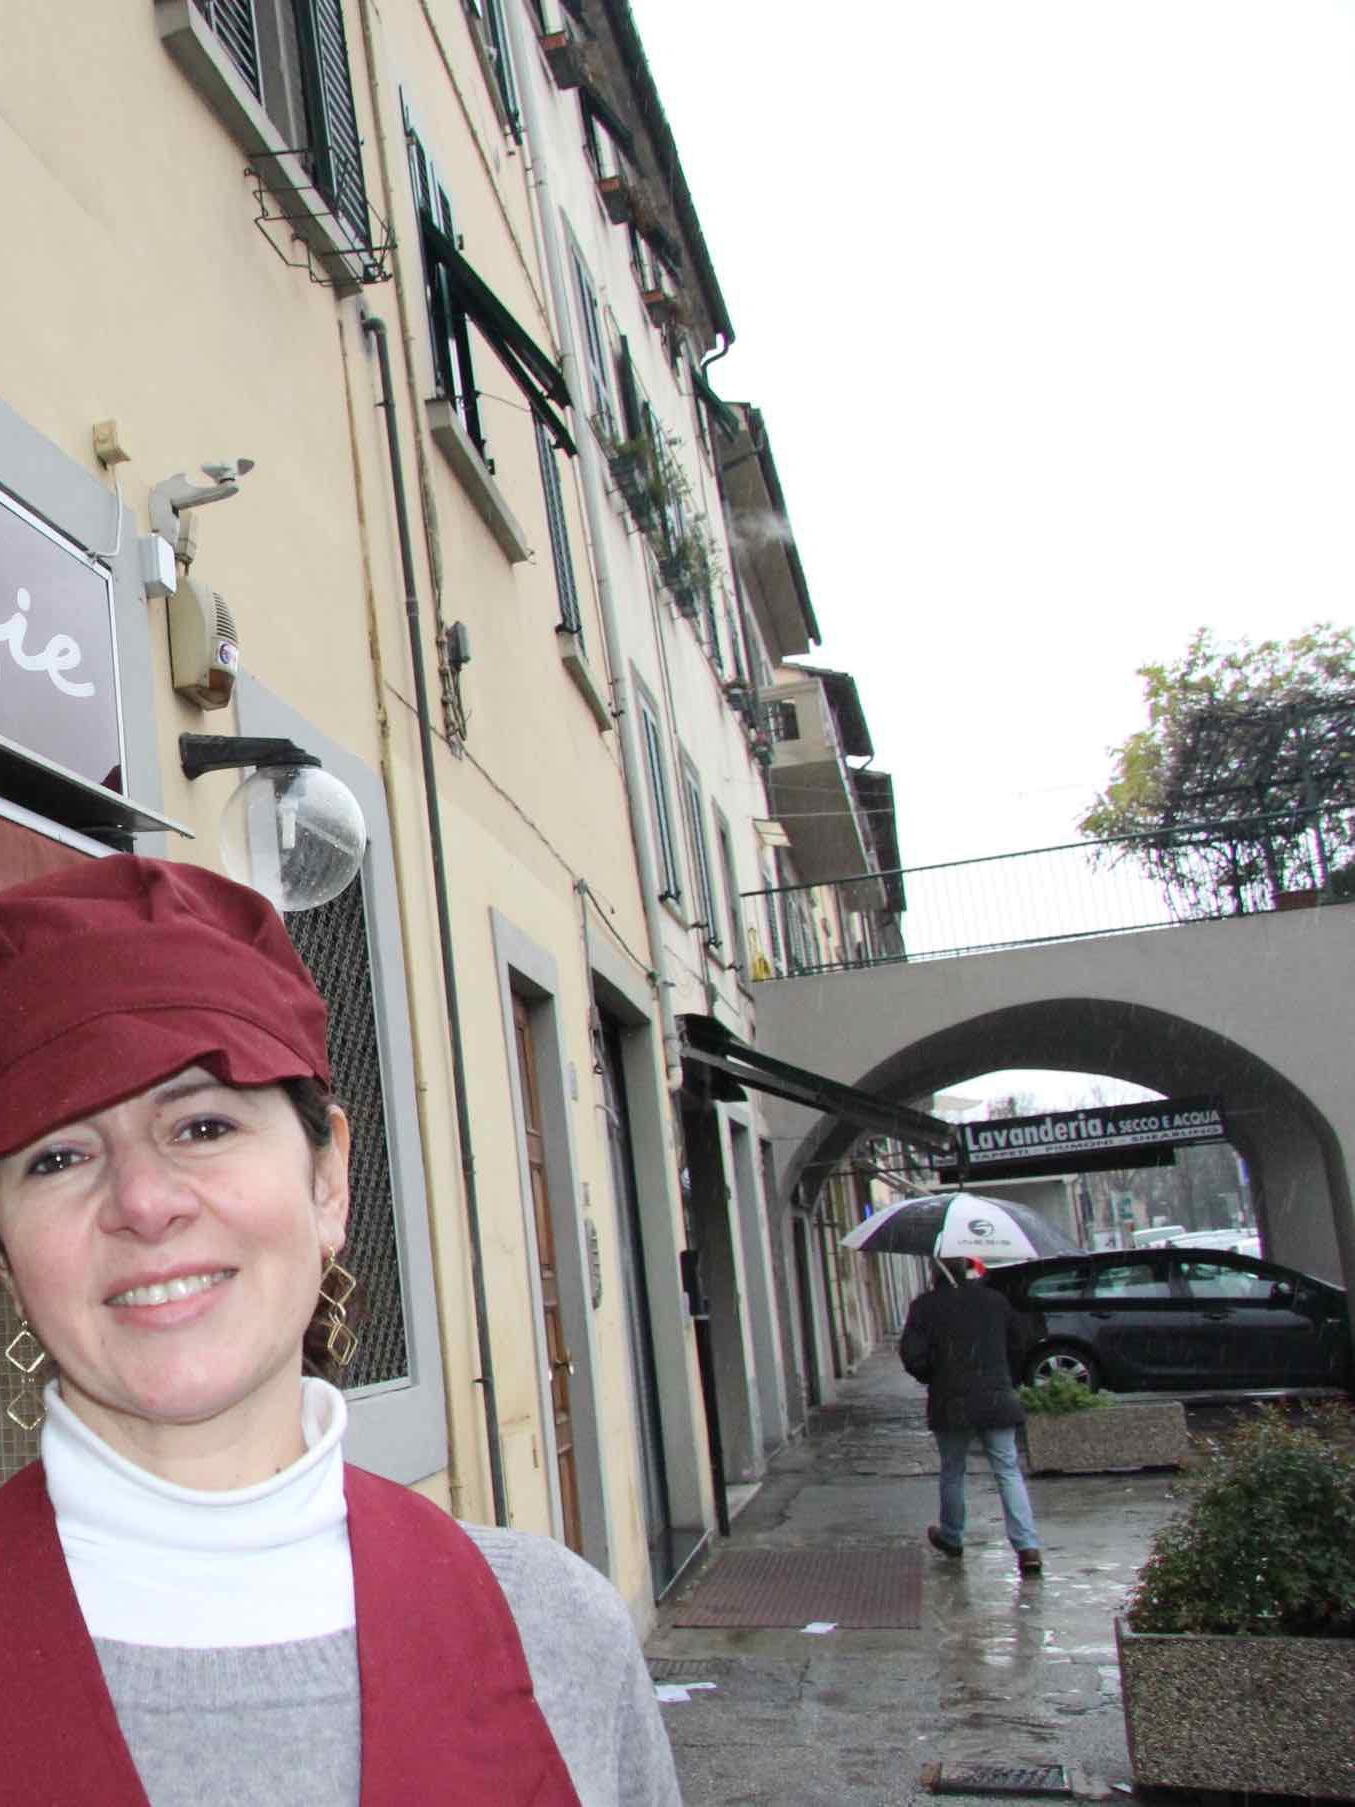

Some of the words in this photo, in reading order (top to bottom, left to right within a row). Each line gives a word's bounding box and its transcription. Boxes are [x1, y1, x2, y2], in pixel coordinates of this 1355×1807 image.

[965, 1113, 1103, 1151] Lavanderia
[1106, 1121, 1117, 1136] A
[1119, 1116, 1159, 1134] SECCO
[1162, 1115, 1170, 1128] E
[1173, 1110, 1221, 1127] ACQUA
